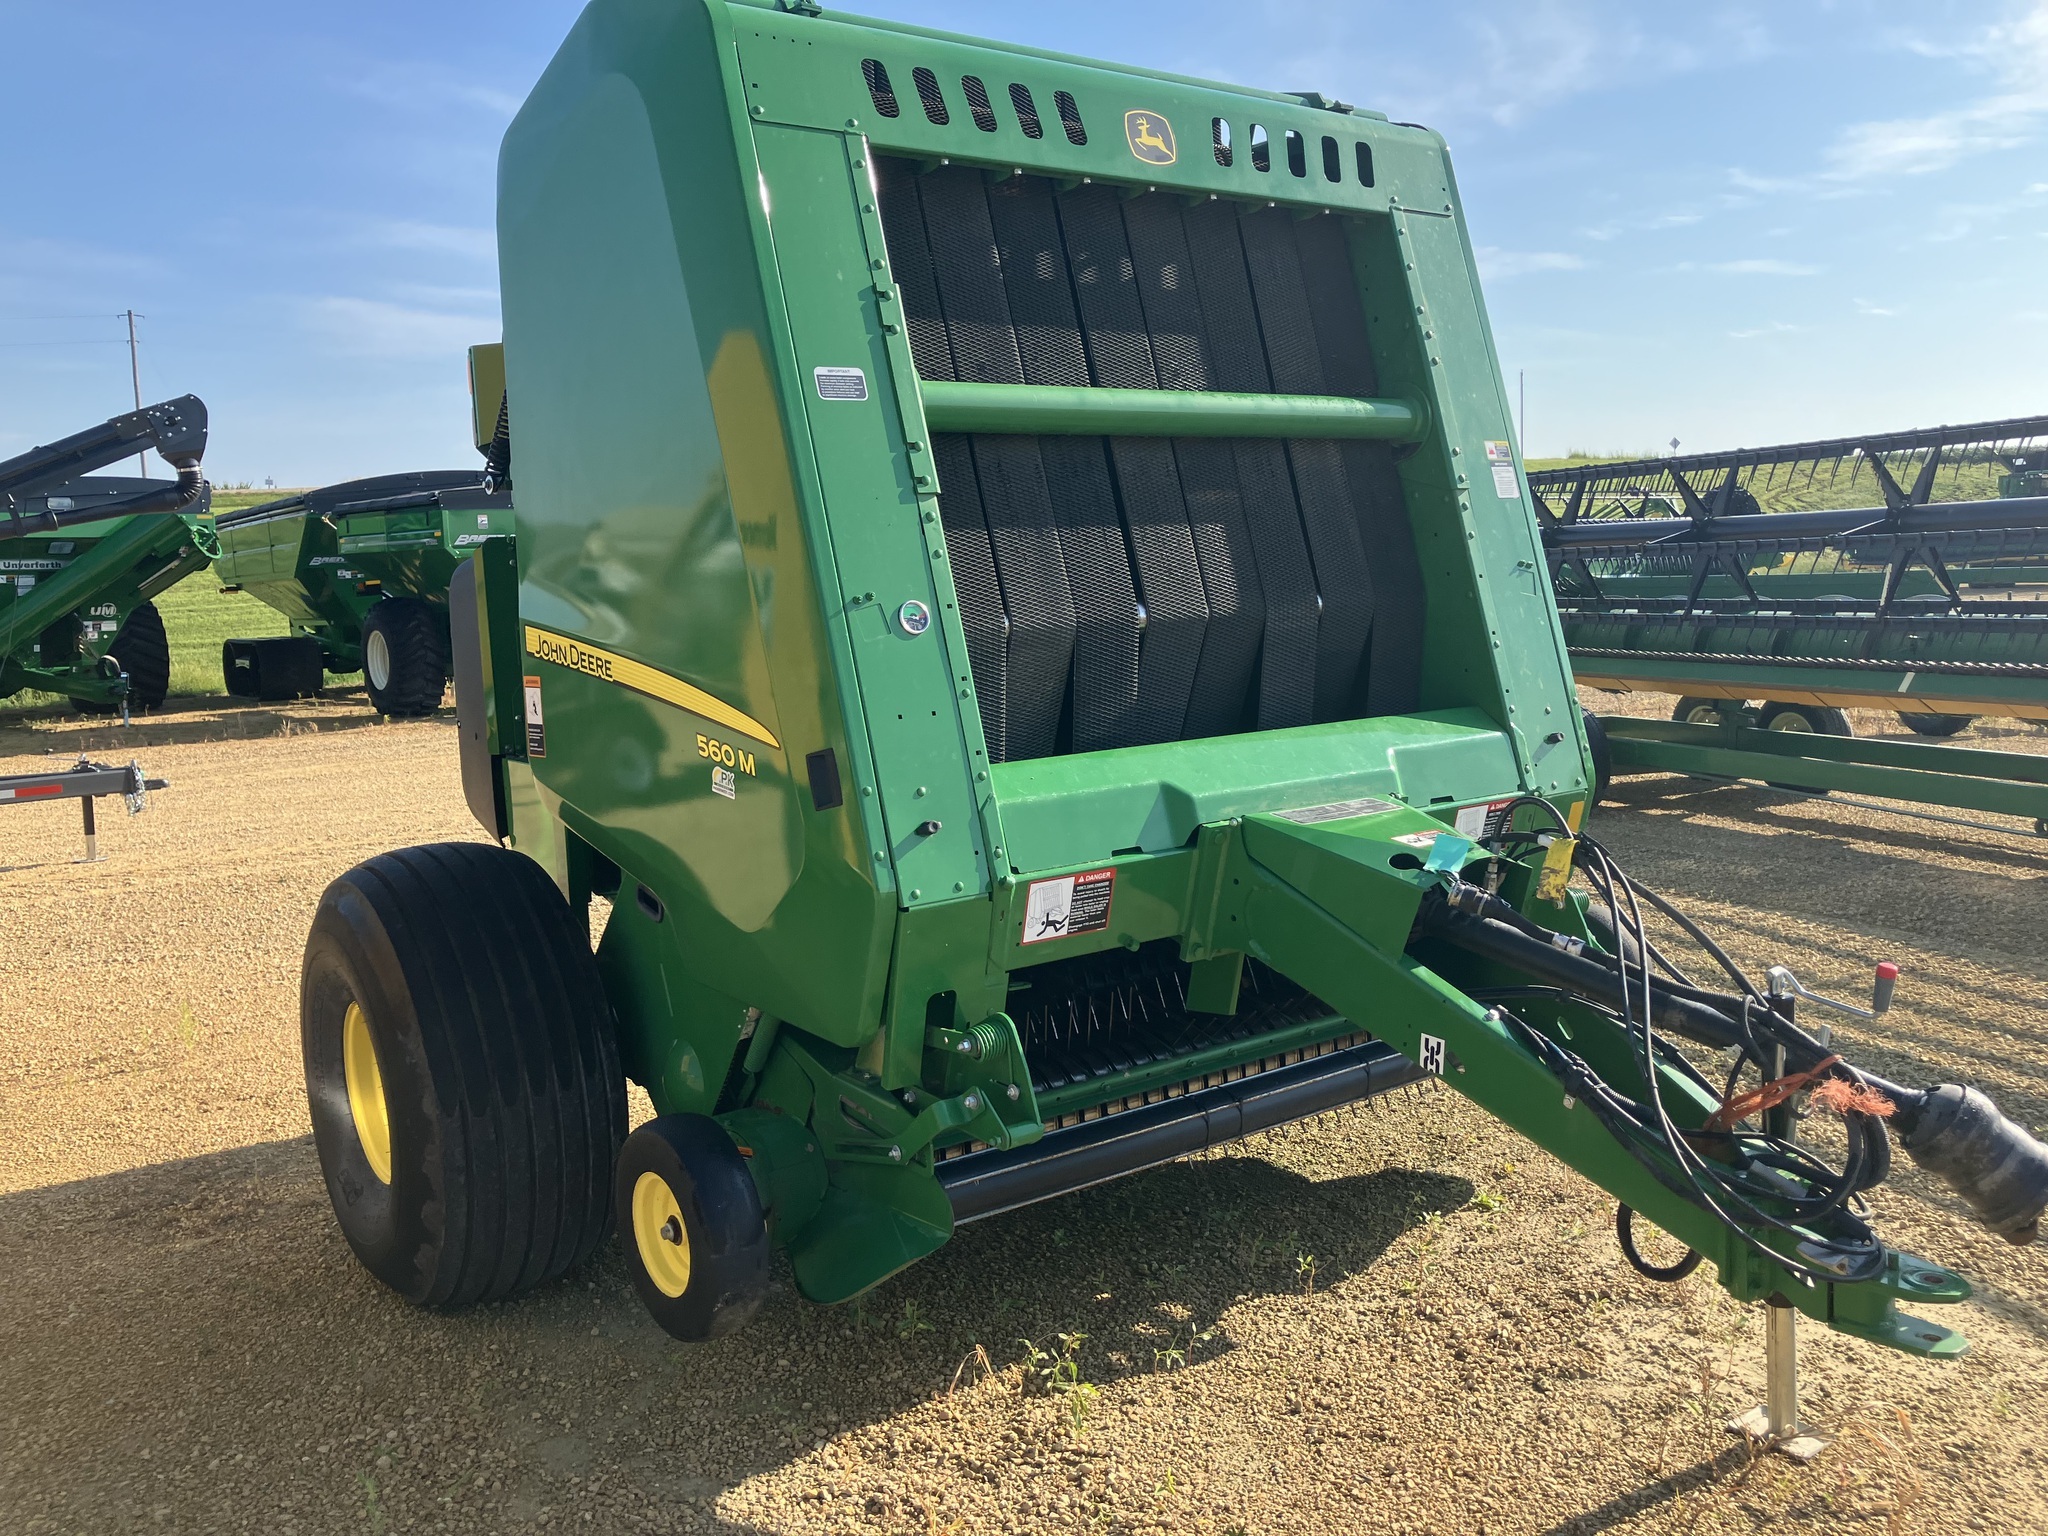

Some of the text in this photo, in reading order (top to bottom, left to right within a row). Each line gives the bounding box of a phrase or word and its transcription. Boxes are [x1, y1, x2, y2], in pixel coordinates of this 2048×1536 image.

[3, 561, 61, 569] Unverferth
[535, 634, 613, 679] JOHN DEERE
[696, 733, 756, 777] 560 M
[1085, 871, 1111, 882] DANGER
